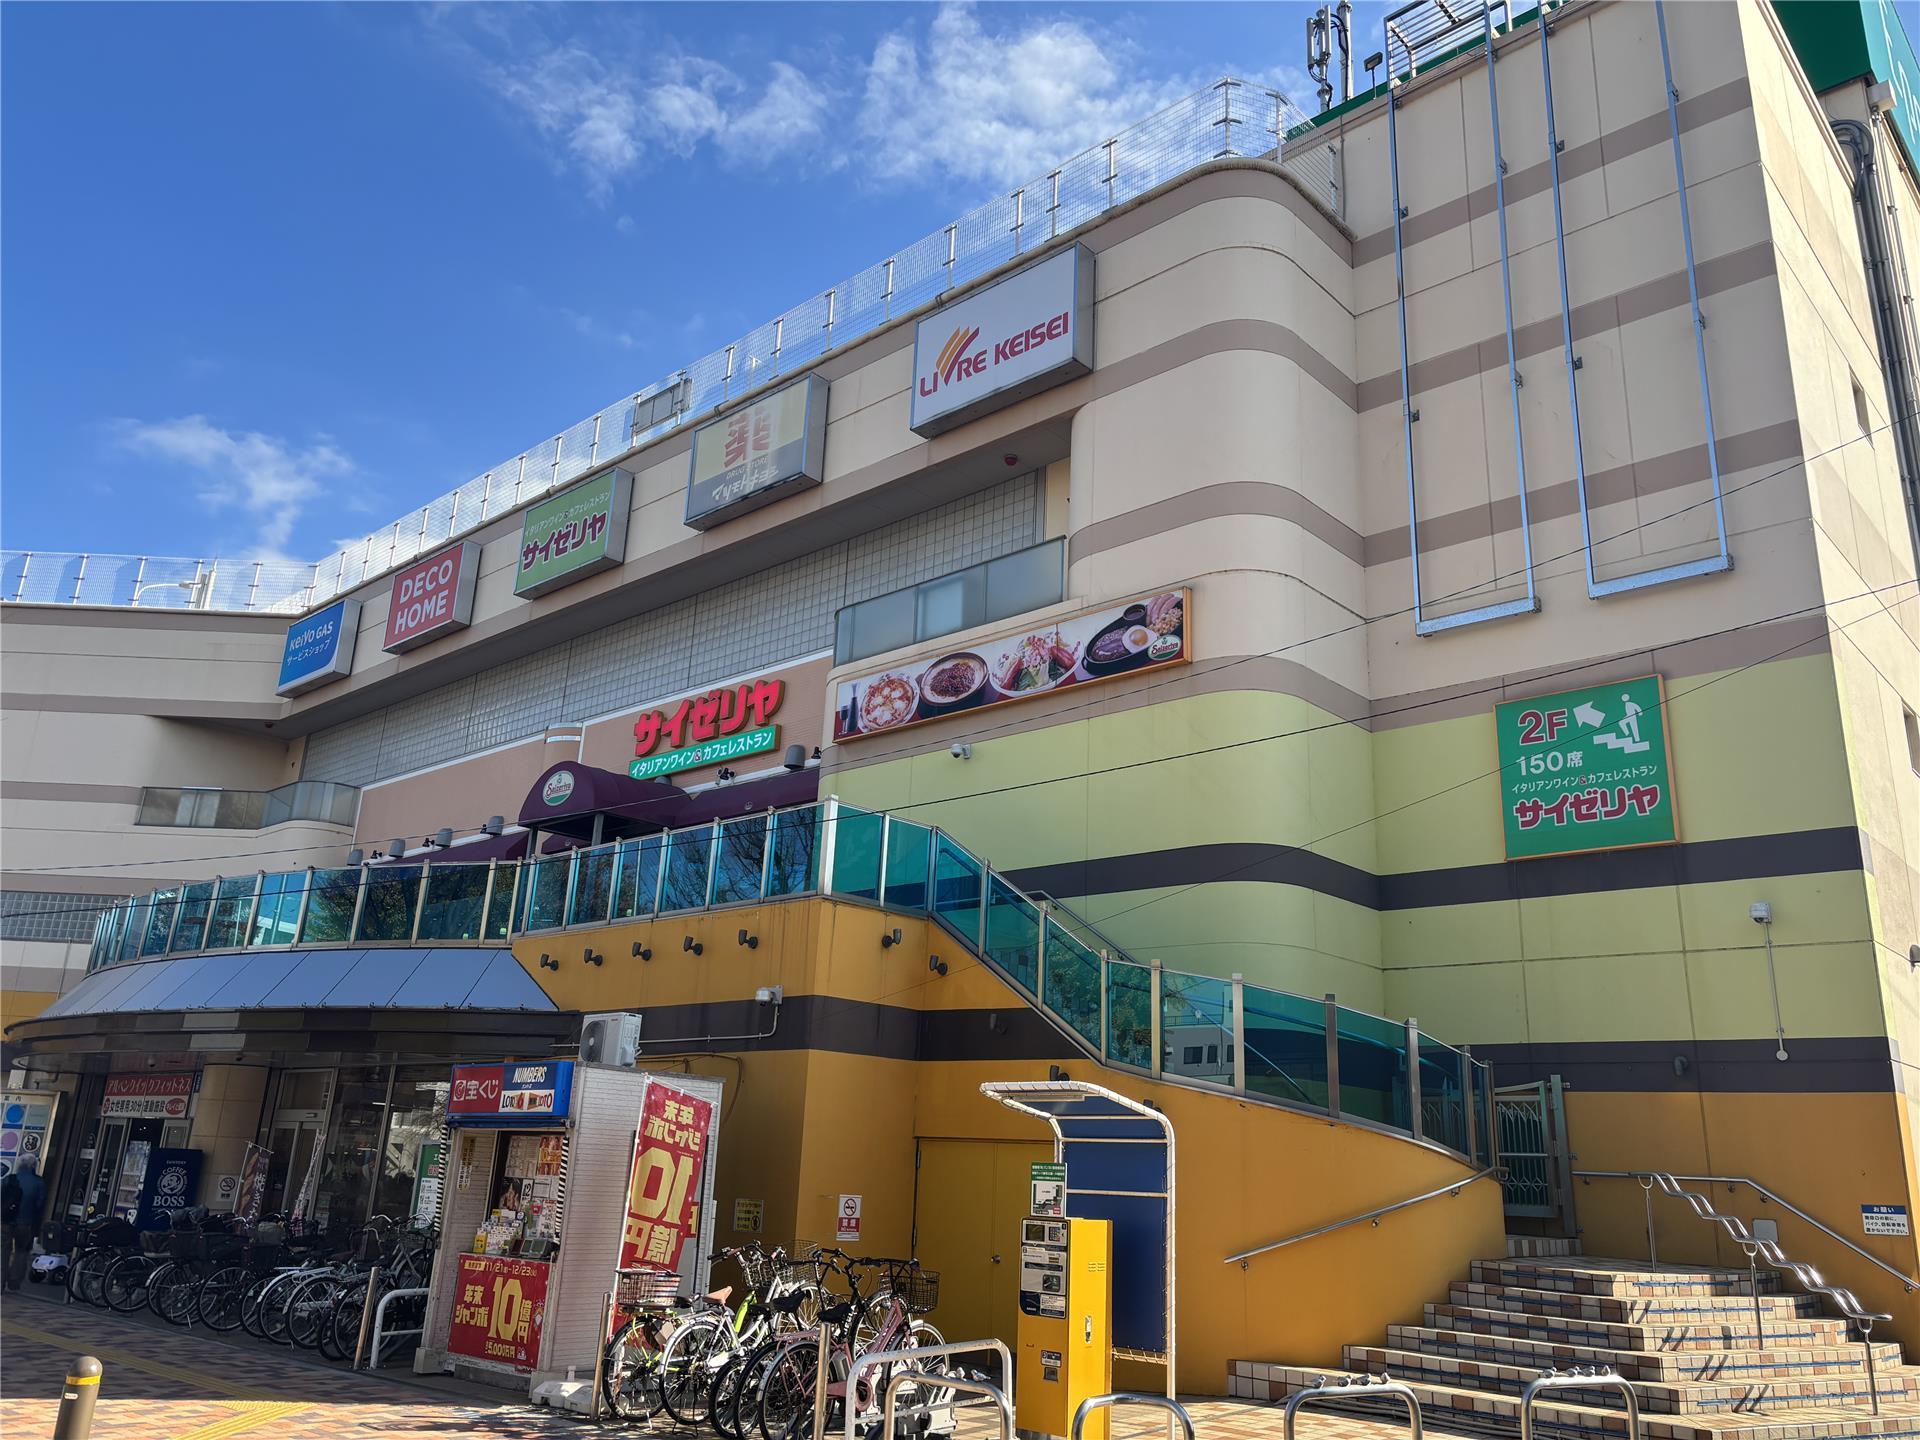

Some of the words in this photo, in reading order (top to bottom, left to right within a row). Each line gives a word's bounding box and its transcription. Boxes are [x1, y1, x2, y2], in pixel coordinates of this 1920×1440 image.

[920, 326, 987, 398] LIVRE
[994, 311, 1069, 365] KEISEI
[521, 511, 608, 573] サイゼリヤ
[400, 559, 453, 604] DECO
[394, 589, 449, 635] HOME
[316, 620, 334, 640] GAS
[633, 679, 786, 757] サイゼリヤ
[1517, 709, 1568, 746] 2F
[1515, 751, 1584, 776] 150席
[1511, 765, 1658, 795] イタリアンワイン&カフェレストラン
[1513, 784, 1661, 830] サイゼリヤ
[465, 1079, 499, 1100] 宝くじ
[512, 1066, 547, 1084] NUMBERS
[162, 1166, 187, 1175] COFFEE
[152, 1195, 185, 1207] BOSS
[463, 1284, 485, 1305] 年末
[487, 1275, 523, 1342] 10
[454, 1303, 490, 1328] ジャンボ
